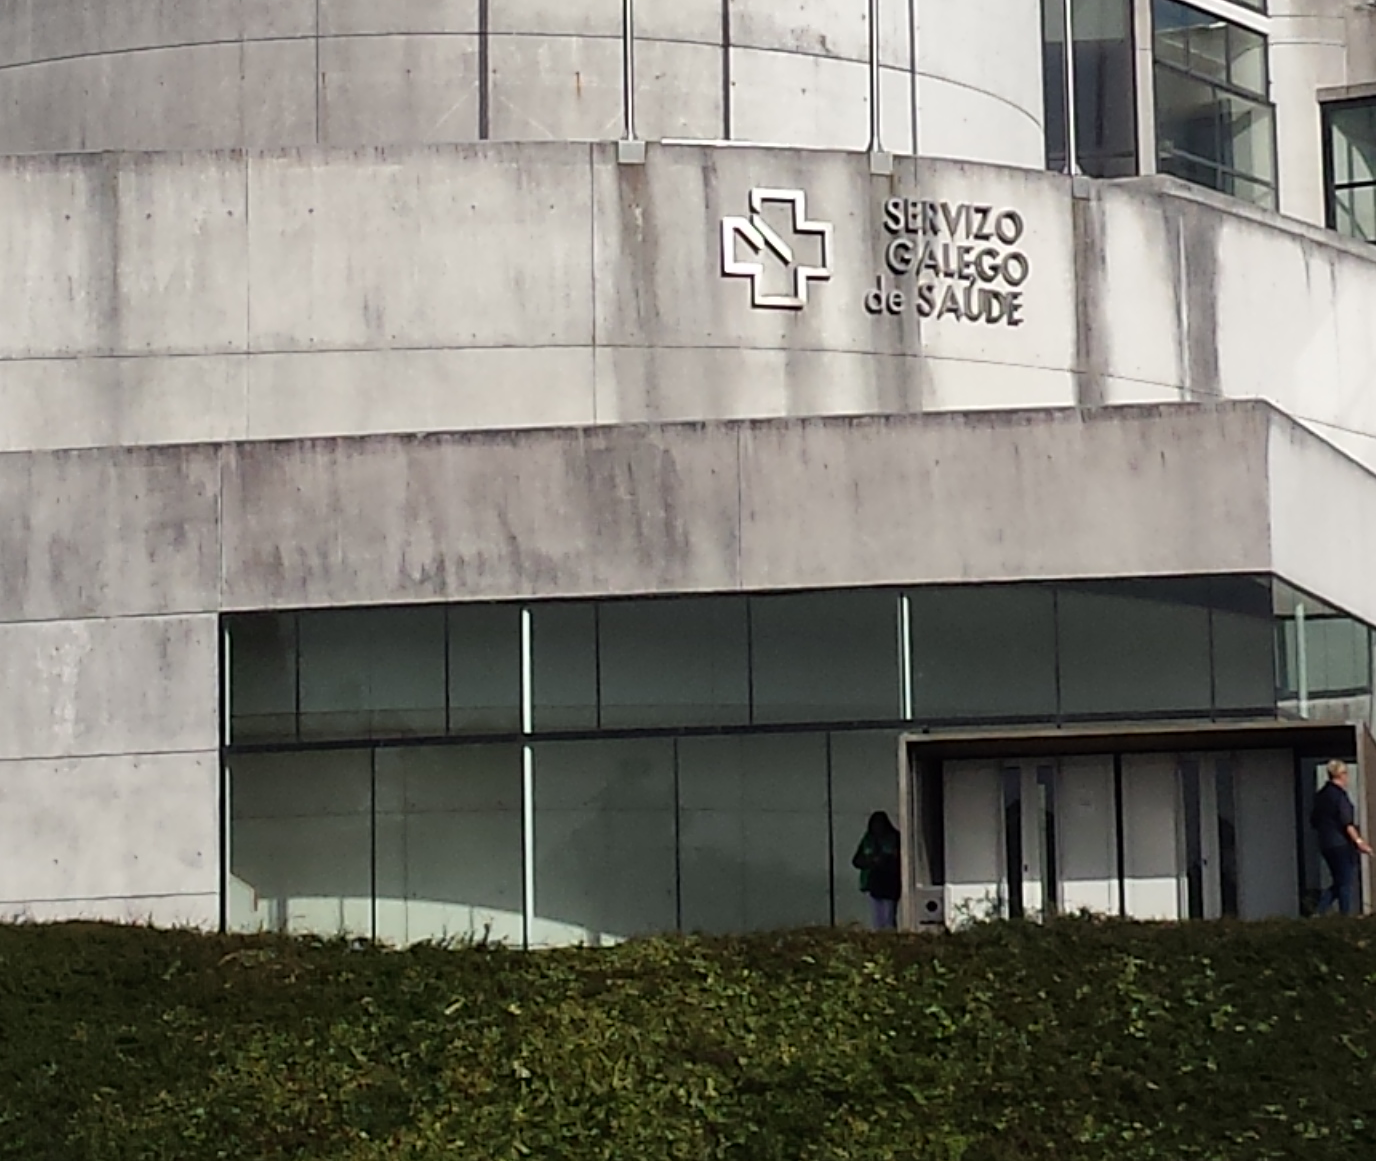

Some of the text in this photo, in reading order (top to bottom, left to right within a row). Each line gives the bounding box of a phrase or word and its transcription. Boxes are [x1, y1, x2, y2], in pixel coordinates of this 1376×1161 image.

[883, 198, 1024, 246] SERVIZO
[885, 238, 1029, 287] GALEGO
[864, 275, 1024, 327] de SAÚDE
